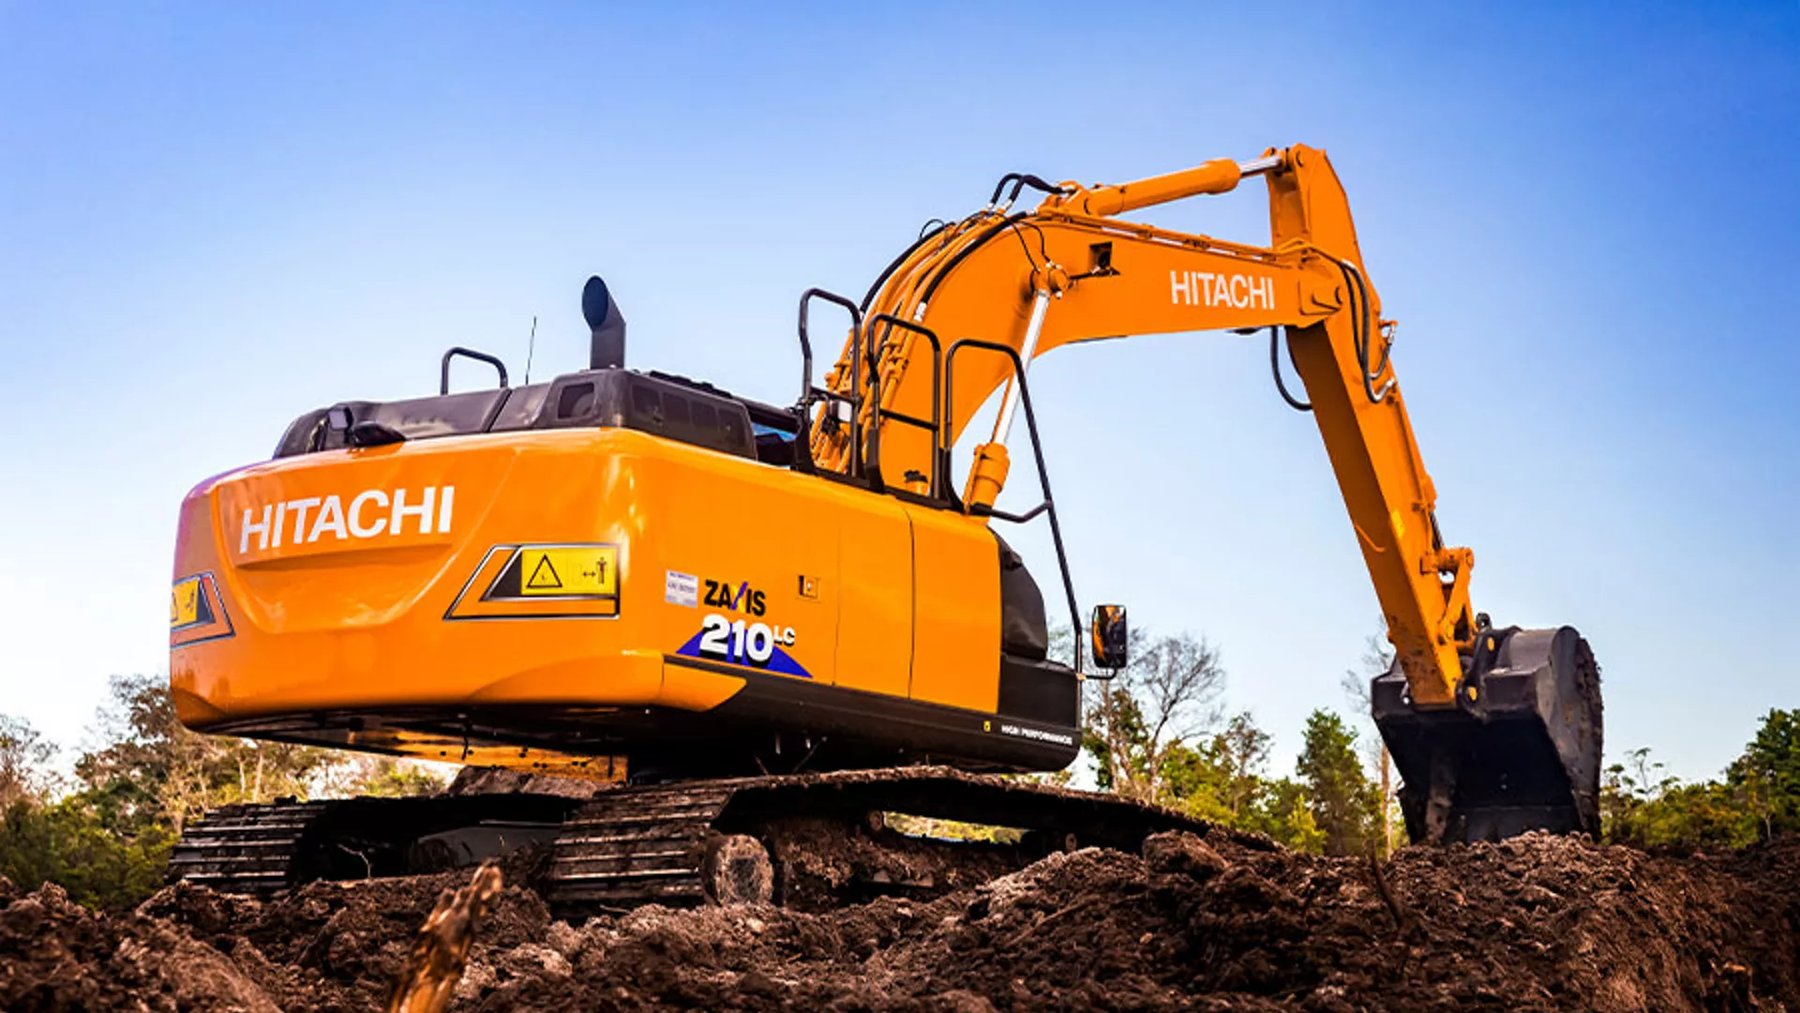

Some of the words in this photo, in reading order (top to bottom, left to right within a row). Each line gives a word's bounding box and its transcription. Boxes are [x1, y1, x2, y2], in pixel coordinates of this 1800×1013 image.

[1169, 270, 1275, 311] HITACHI
[239, 485, 455, 555] HITACHI
[703, 579, 766, 617] ZAXIS
